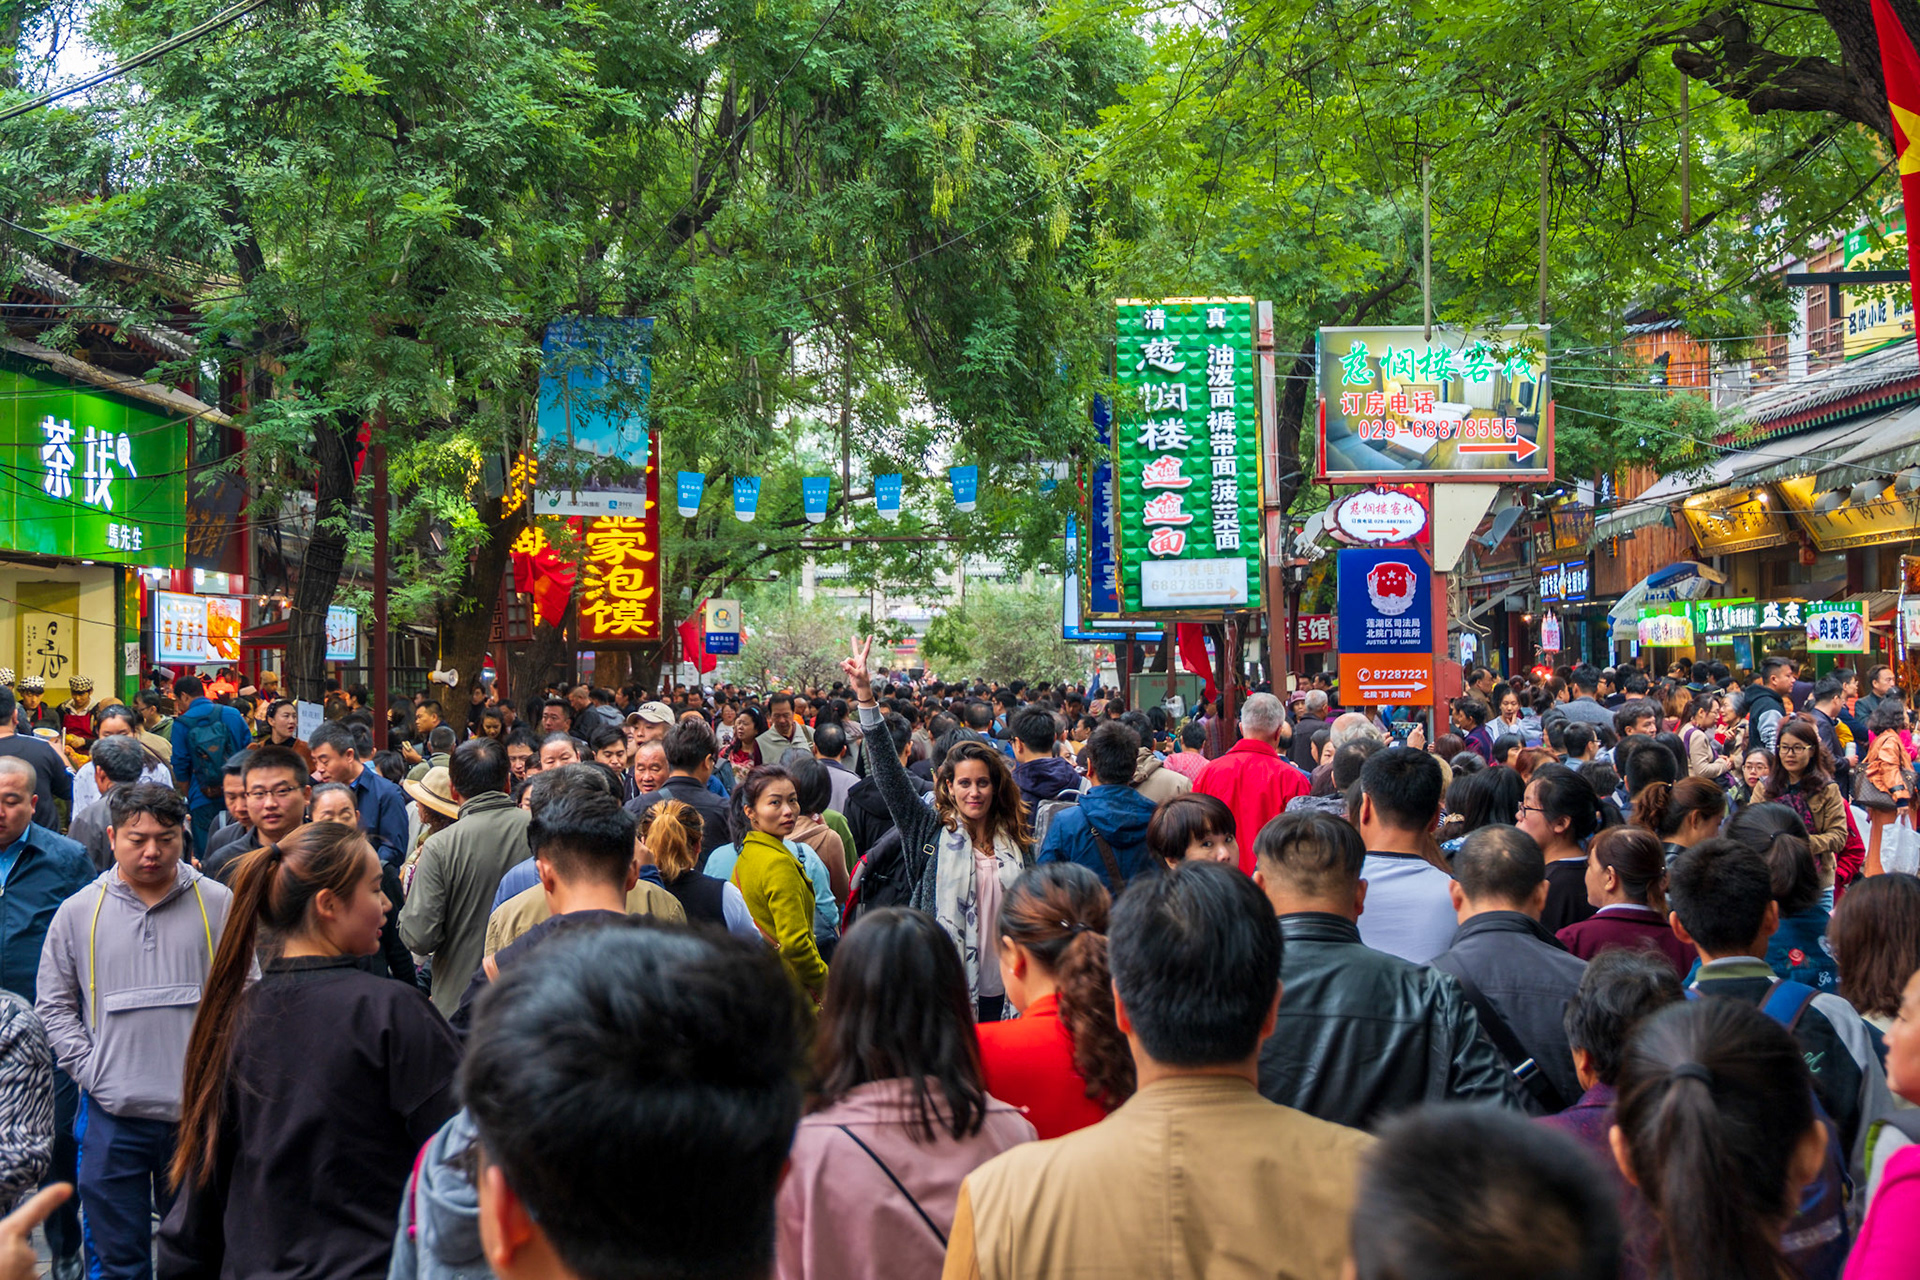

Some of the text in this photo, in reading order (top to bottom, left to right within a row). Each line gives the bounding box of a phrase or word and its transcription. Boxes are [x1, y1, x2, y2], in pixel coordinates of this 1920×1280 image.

[1340, 391, 1435, 417] 订房电话
[1358, 420, 1517, 440] 029-68878555
[108, 522, 143, 552] 馬先生
[1151, 578, 1224, 592] 68878555
[1366, 617, 1421, 628] 莲湖区司法局
[1820, 616, 1850, 640] 肉夹馍
[1366, 628, 1421, 638] 北院门司法所
[1373, 669, 1428, 680] 87287221
